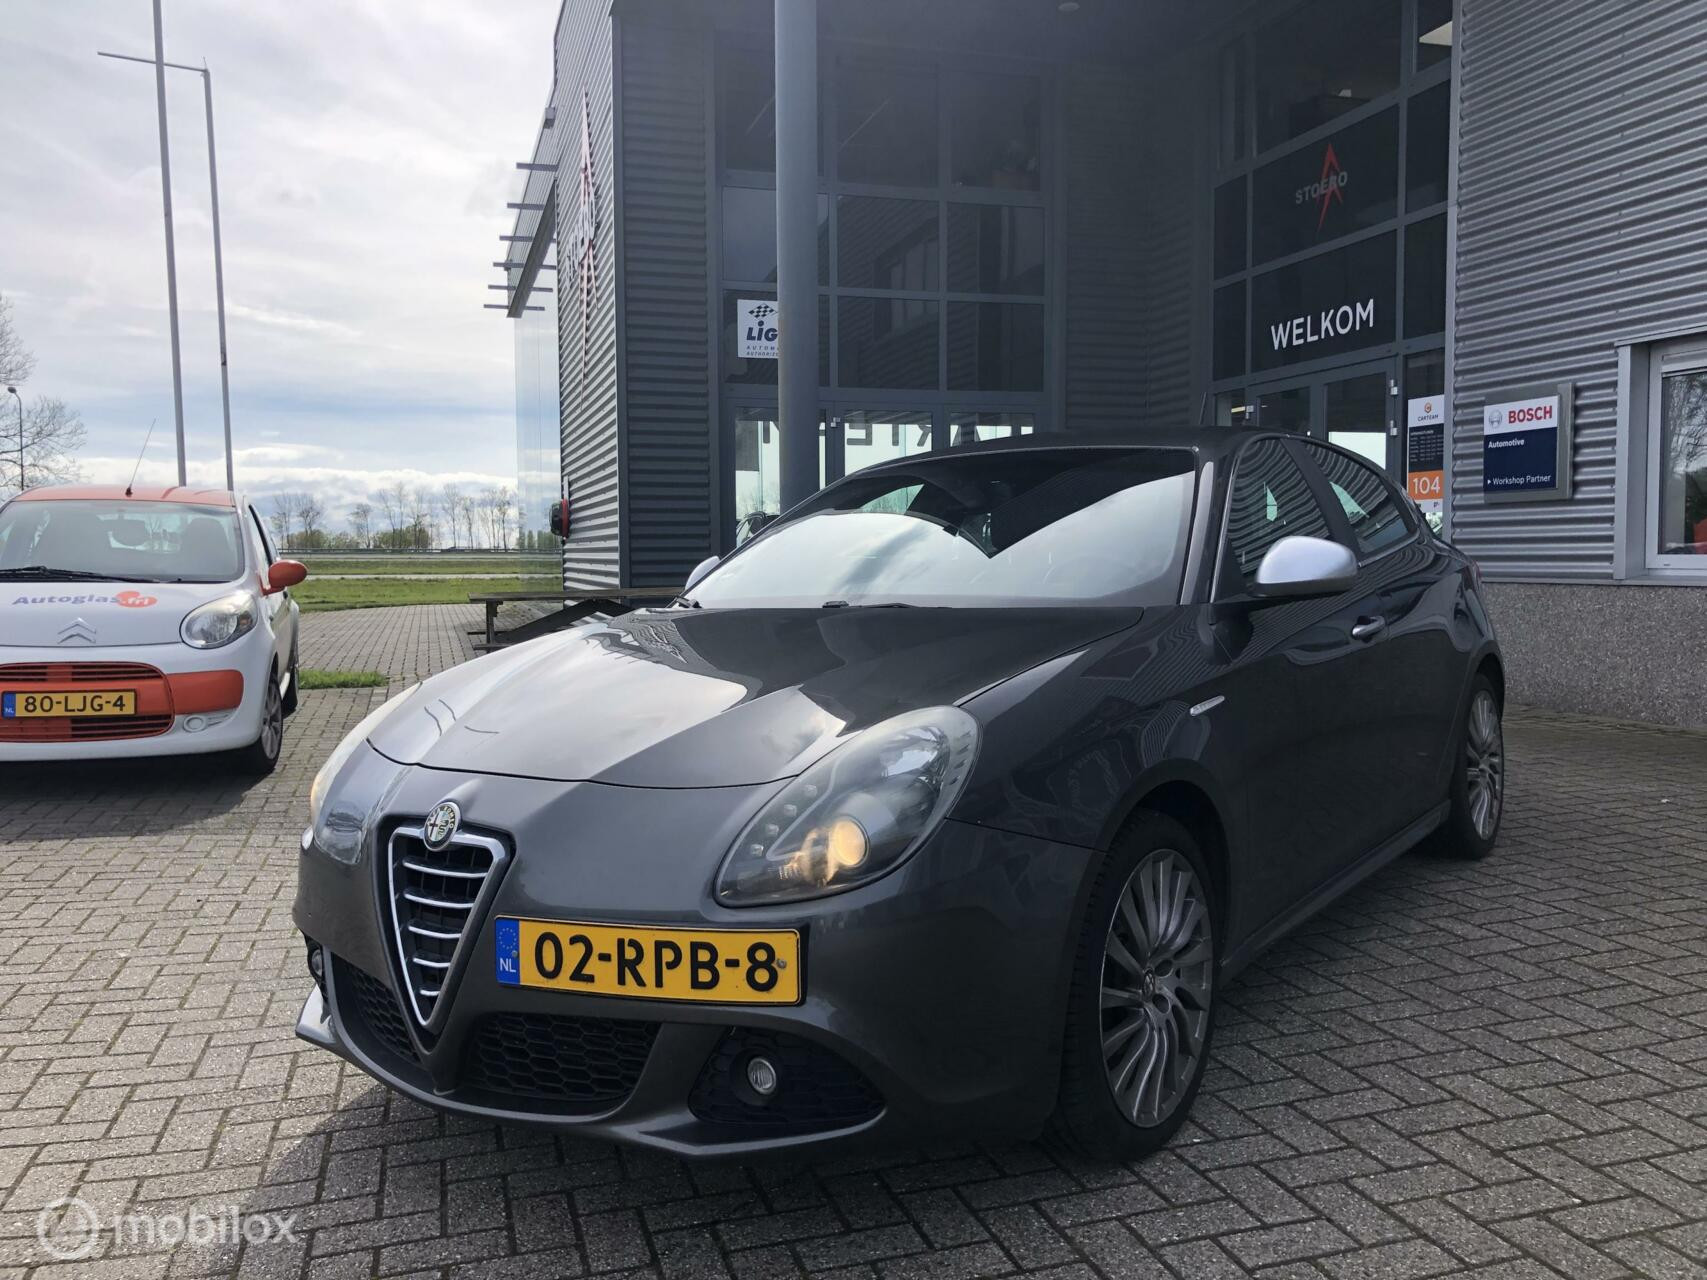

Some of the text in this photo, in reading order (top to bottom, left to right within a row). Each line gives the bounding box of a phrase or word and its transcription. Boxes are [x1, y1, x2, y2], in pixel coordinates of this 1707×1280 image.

[1270, 298, 1374, 351] WELKOM
[1417, 414, 1439, 422] CARTEAM
[1508, 405, 1553, 424] BOSCH
[1488, 438, 1525, 449] Automotive
[1412, 476, 1441, 495] 104
[1492, 475, 1551, 485] Workshop Partner
[24, 695, 126, 713] 80-LJG-4
[499, 958, 516, 973] NL
[534, 931, 779, 992] 02-RPB-8
